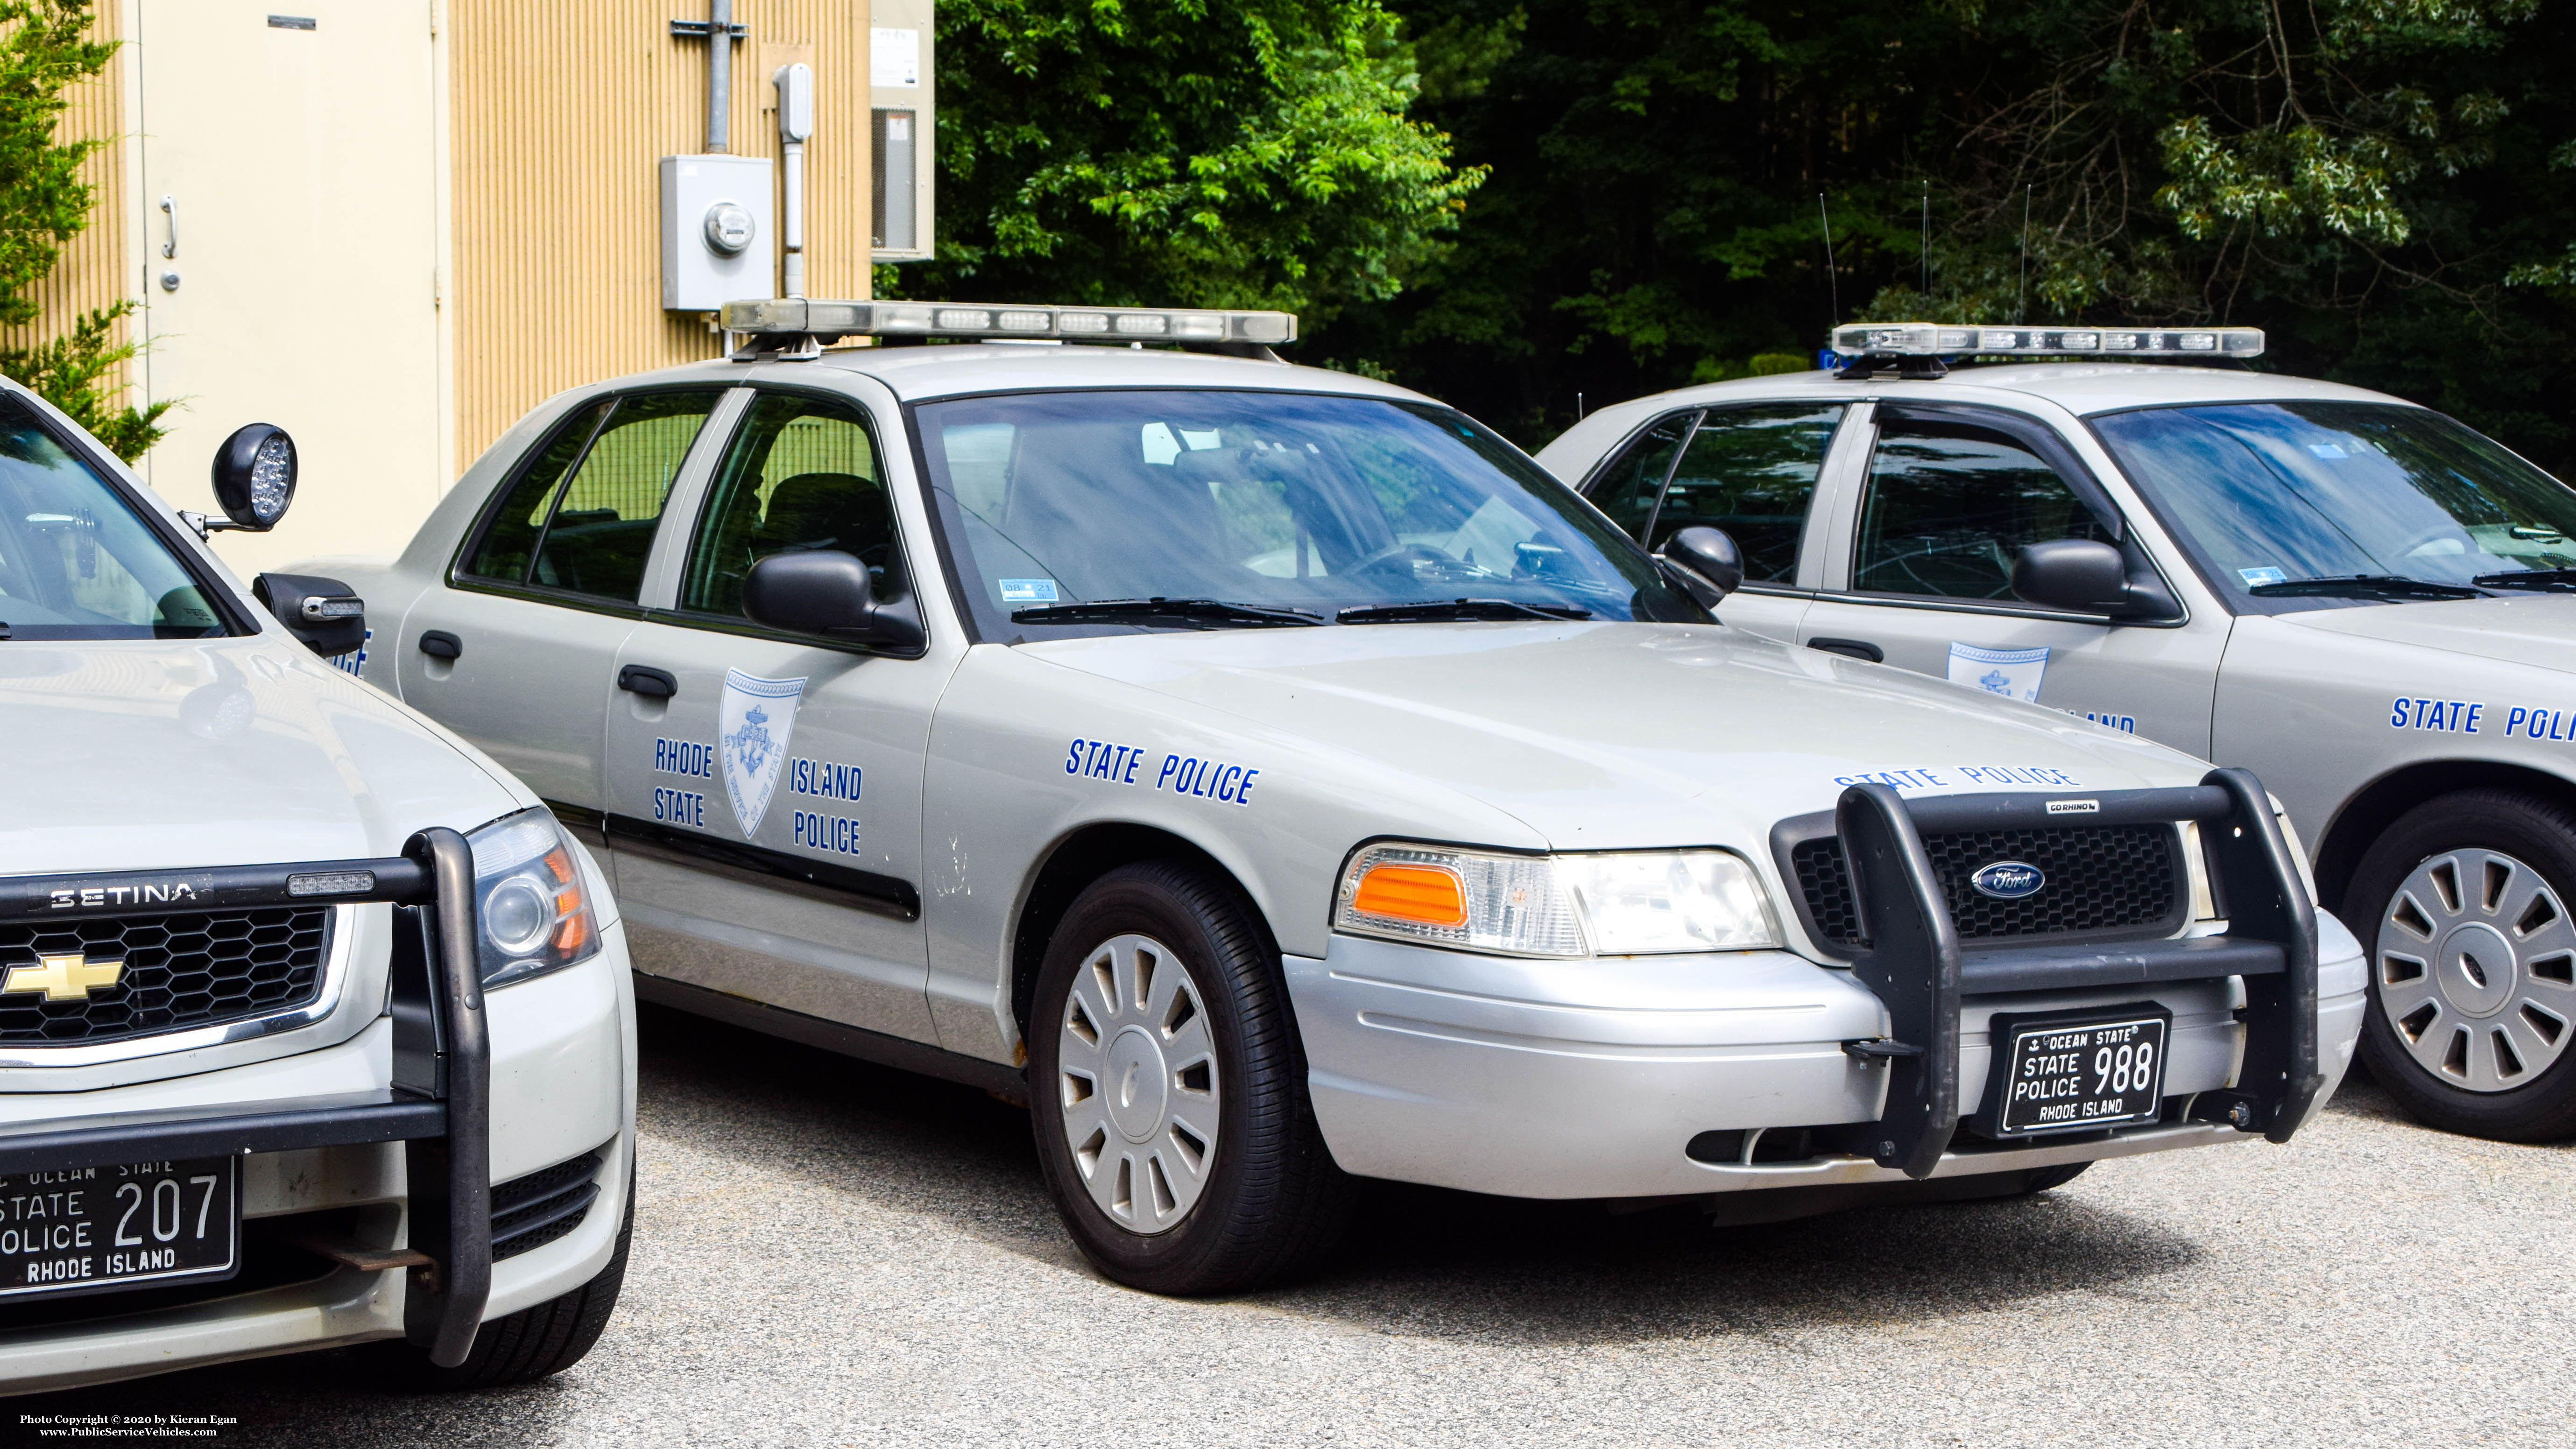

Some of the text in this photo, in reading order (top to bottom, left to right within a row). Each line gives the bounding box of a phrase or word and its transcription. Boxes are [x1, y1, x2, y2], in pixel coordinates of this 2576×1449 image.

[2391, 698, 2484, 733] STATE
[655, 738, 862, 802] RHODE ISLAND
[1065, 738, 1260, 805] STATE POLICE
[1957, 767, 2082, 786] POLICE
[655, 788, 860, 856] STATE POLICE
[51, 883, 197, 908] SETINA
[1993, 867, 2032, 889] Ford
[2049, 1028, 2131, 1050] OCEAN STATE
[2024, 1042, 2153, 1096] STATE 988
[2015, 1076, 2081, 1101] POLICE
[2039, 1098, 2123, 1121] RHODE ISLAND
[115, 1175, 217, 1247] 207
[28, 1248, 175, 1283] RHODE ISLAND
